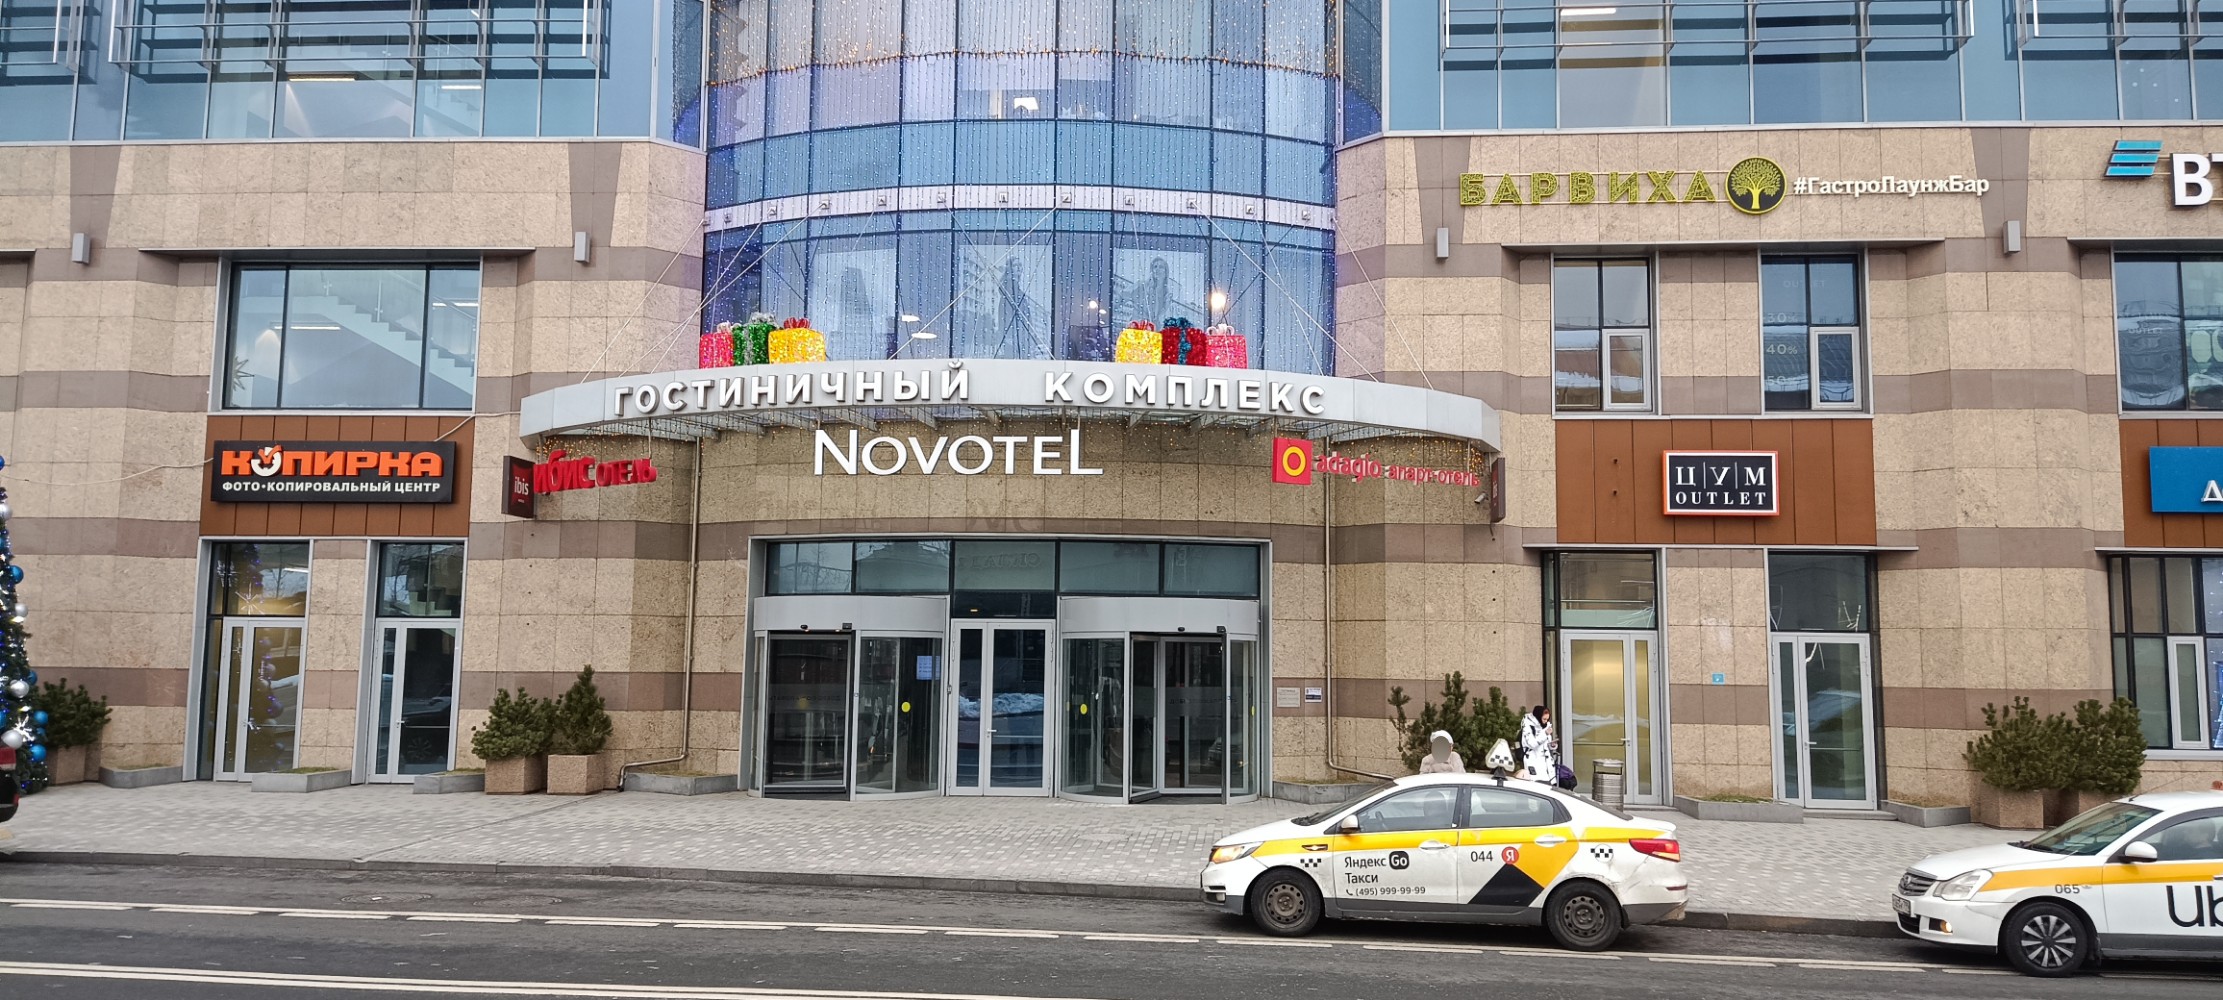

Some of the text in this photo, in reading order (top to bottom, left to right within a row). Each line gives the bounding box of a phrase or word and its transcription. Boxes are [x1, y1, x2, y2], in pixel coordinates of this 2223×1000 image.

[1460, 170, 1716, 206] БАРВИХА
[1794, 175, 1990, 198] #ГастроЛаунжБар
[2170, 153, 2223, 207] В
[614, 359, 1325, 416] ГОСТИНИЧНЫЙ КОМПЛЕКС
[221, 445, 444, 477] КОПИРКА
[1314, 451, 1383, 483] adagio
[394, 482, 441, 494] ЦЕНТР
[514, 476, 529, 496] ibis
[2201, 480, 2223, 502] Д
[1675, 491, 1767, 505] OUTLET
[1344, 853, 1408, 869] Яндекс Go
[1470, 850, 1494, 862] 044
[1344, 872, 1379, 884] Такси
[1355, 887, 1378, 897] (495)
[2055, 883, 2080, 894] 065
